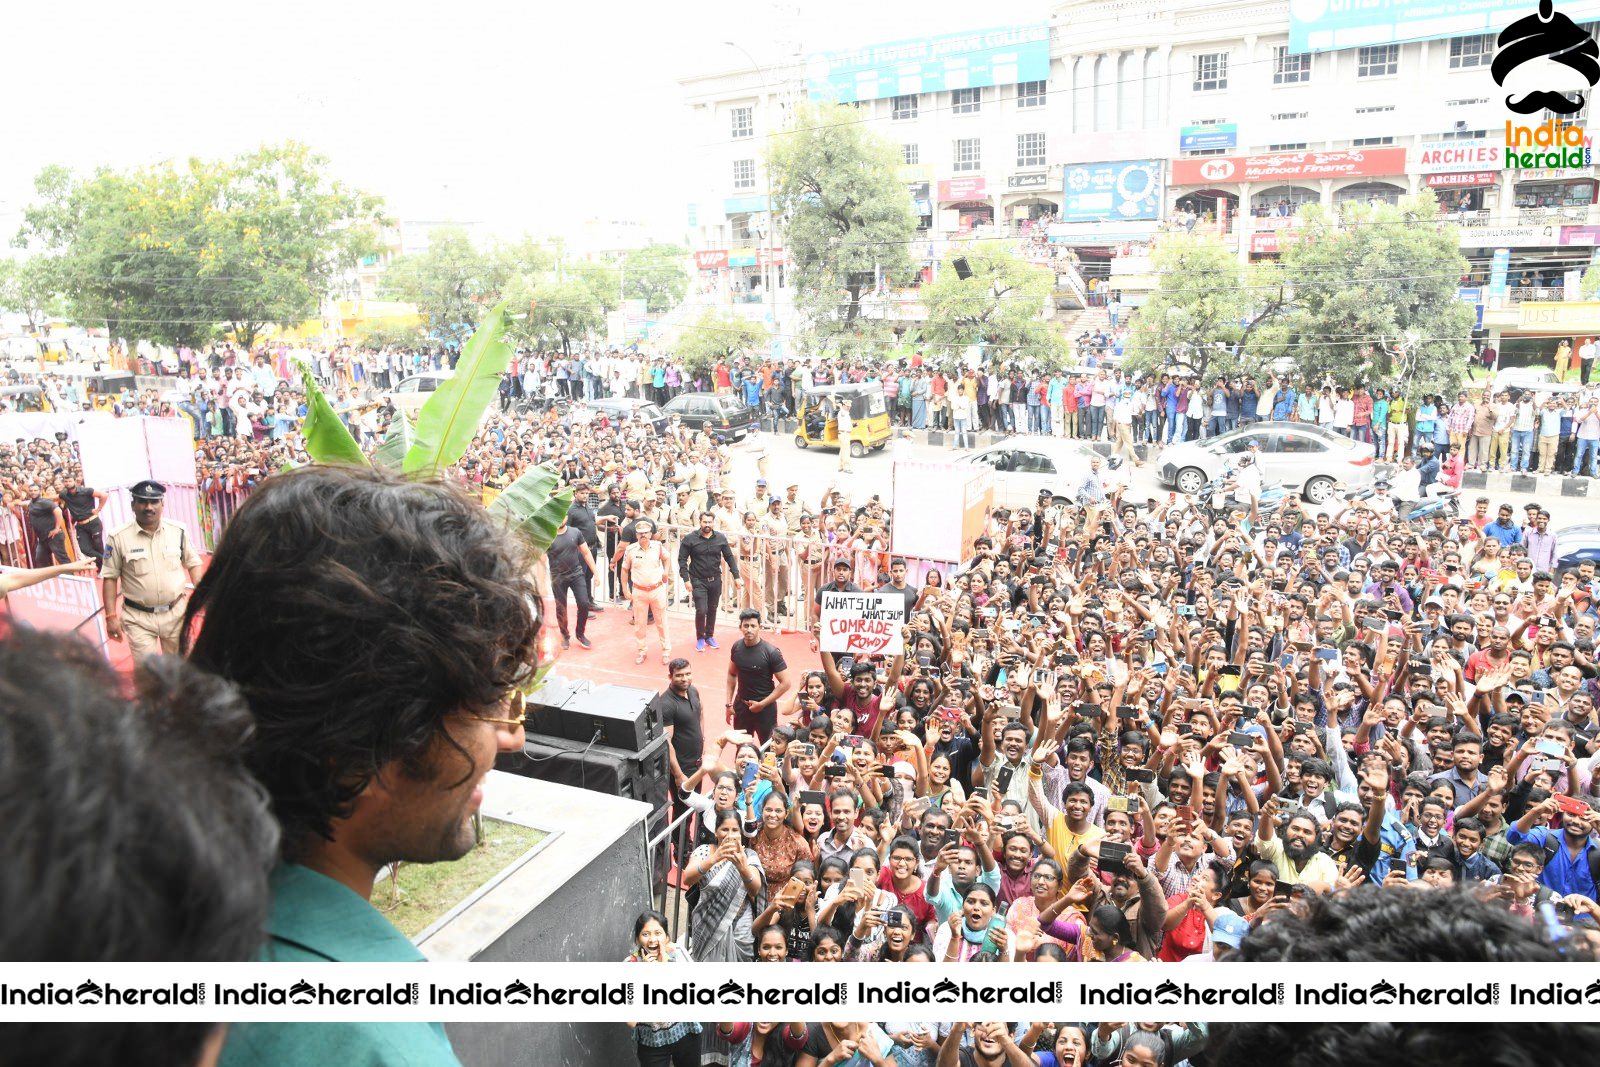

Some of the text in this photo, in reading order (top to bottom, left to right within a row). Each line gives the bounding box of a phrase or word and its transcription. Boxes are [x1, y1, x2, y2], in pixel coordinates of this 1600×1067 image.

[873, 42, 929, 64] FLOWER
[931, 35, 982, 58] JUNIOR
[985, 27, 1048, 49] COLLEGE
[1421, 146, 1499, 165] ARCHIES
[1245, 166, 1302, 176] Muthoot
[1302, 163, 1356, 174] Finance
[1523, 169, 1565, 179] TOYS IN
[1428, 174, 1475, 185] ARCHIES
[1499, 229, 1533, 237] FURNISHING
[699, 252, 724, 265] VIP
[825, 596, 882, 611] WHAT'S UP
[830, 619, 893, 636] COMRADE
